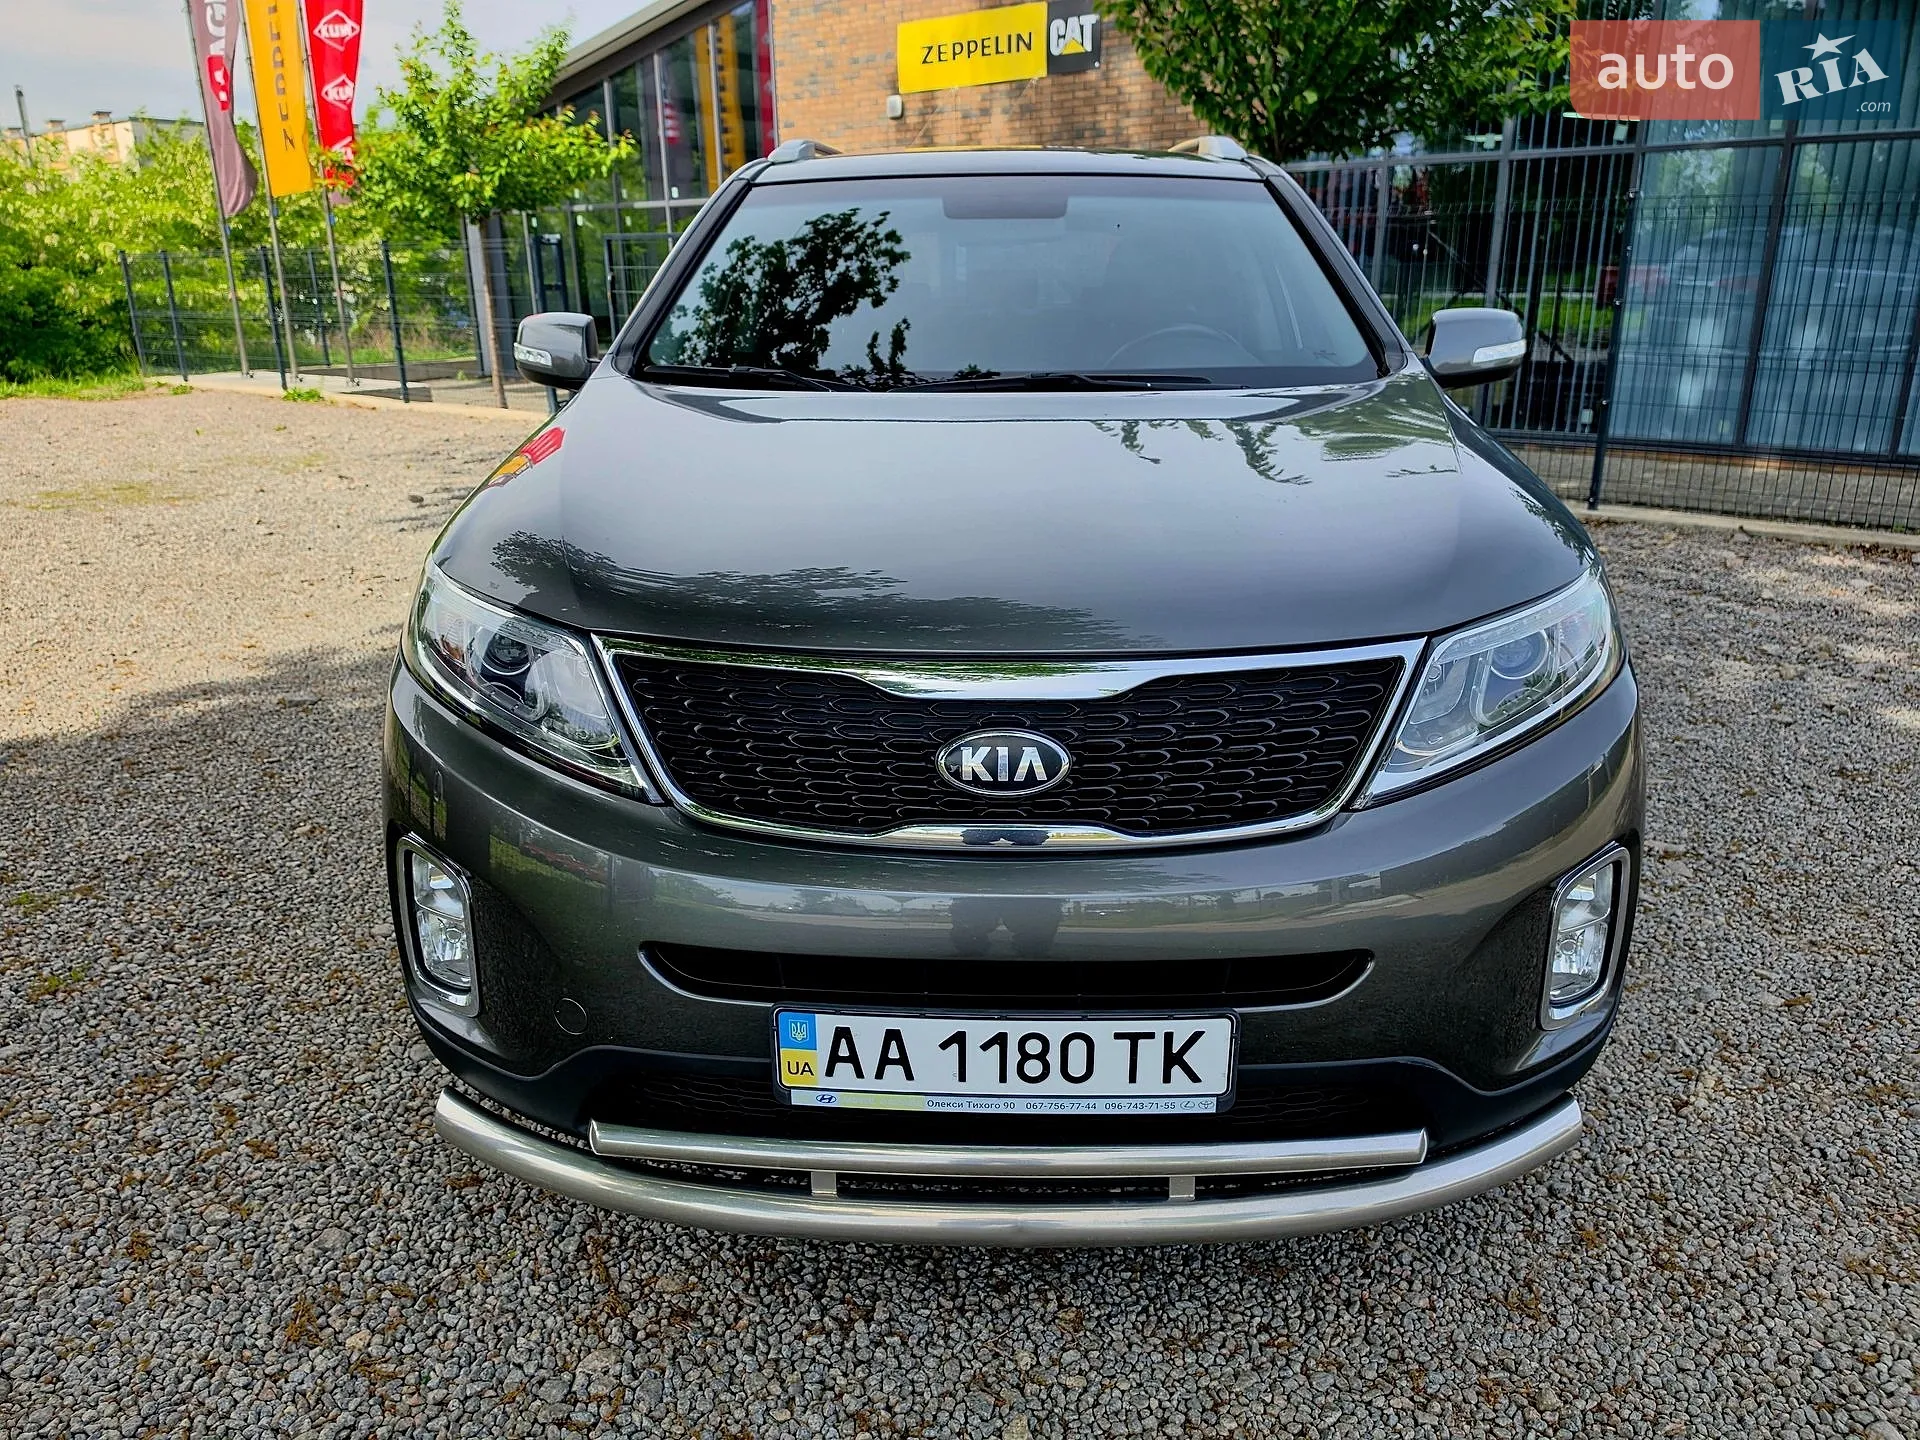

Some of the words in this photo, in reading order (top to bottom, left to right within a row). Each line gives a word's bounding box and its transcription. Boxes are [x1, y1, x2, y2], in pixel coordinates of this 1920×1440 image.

[921, 31, 1032, 64] ZEPPELIN
[1049, 13, 1099, 56] CAT
[960, 746, 1048, 782] KIA
[786, 1061, 814, 1076] UA
[825, 1026, 915, 1081] AA
[938, 1030, 1095, 1084] 1180
[1113, 1030, 1206, 1084] TK
[926, 1099, 964, 1109] Олекси
[966, 1100, 1001, 1110] Тихого
[1003, 1101, 1016, 1110] 90
[1025, 1102, 1097, 1110] 067-756-77-44
[1104, 1101, 1176, 1110] 096-743-71-55
